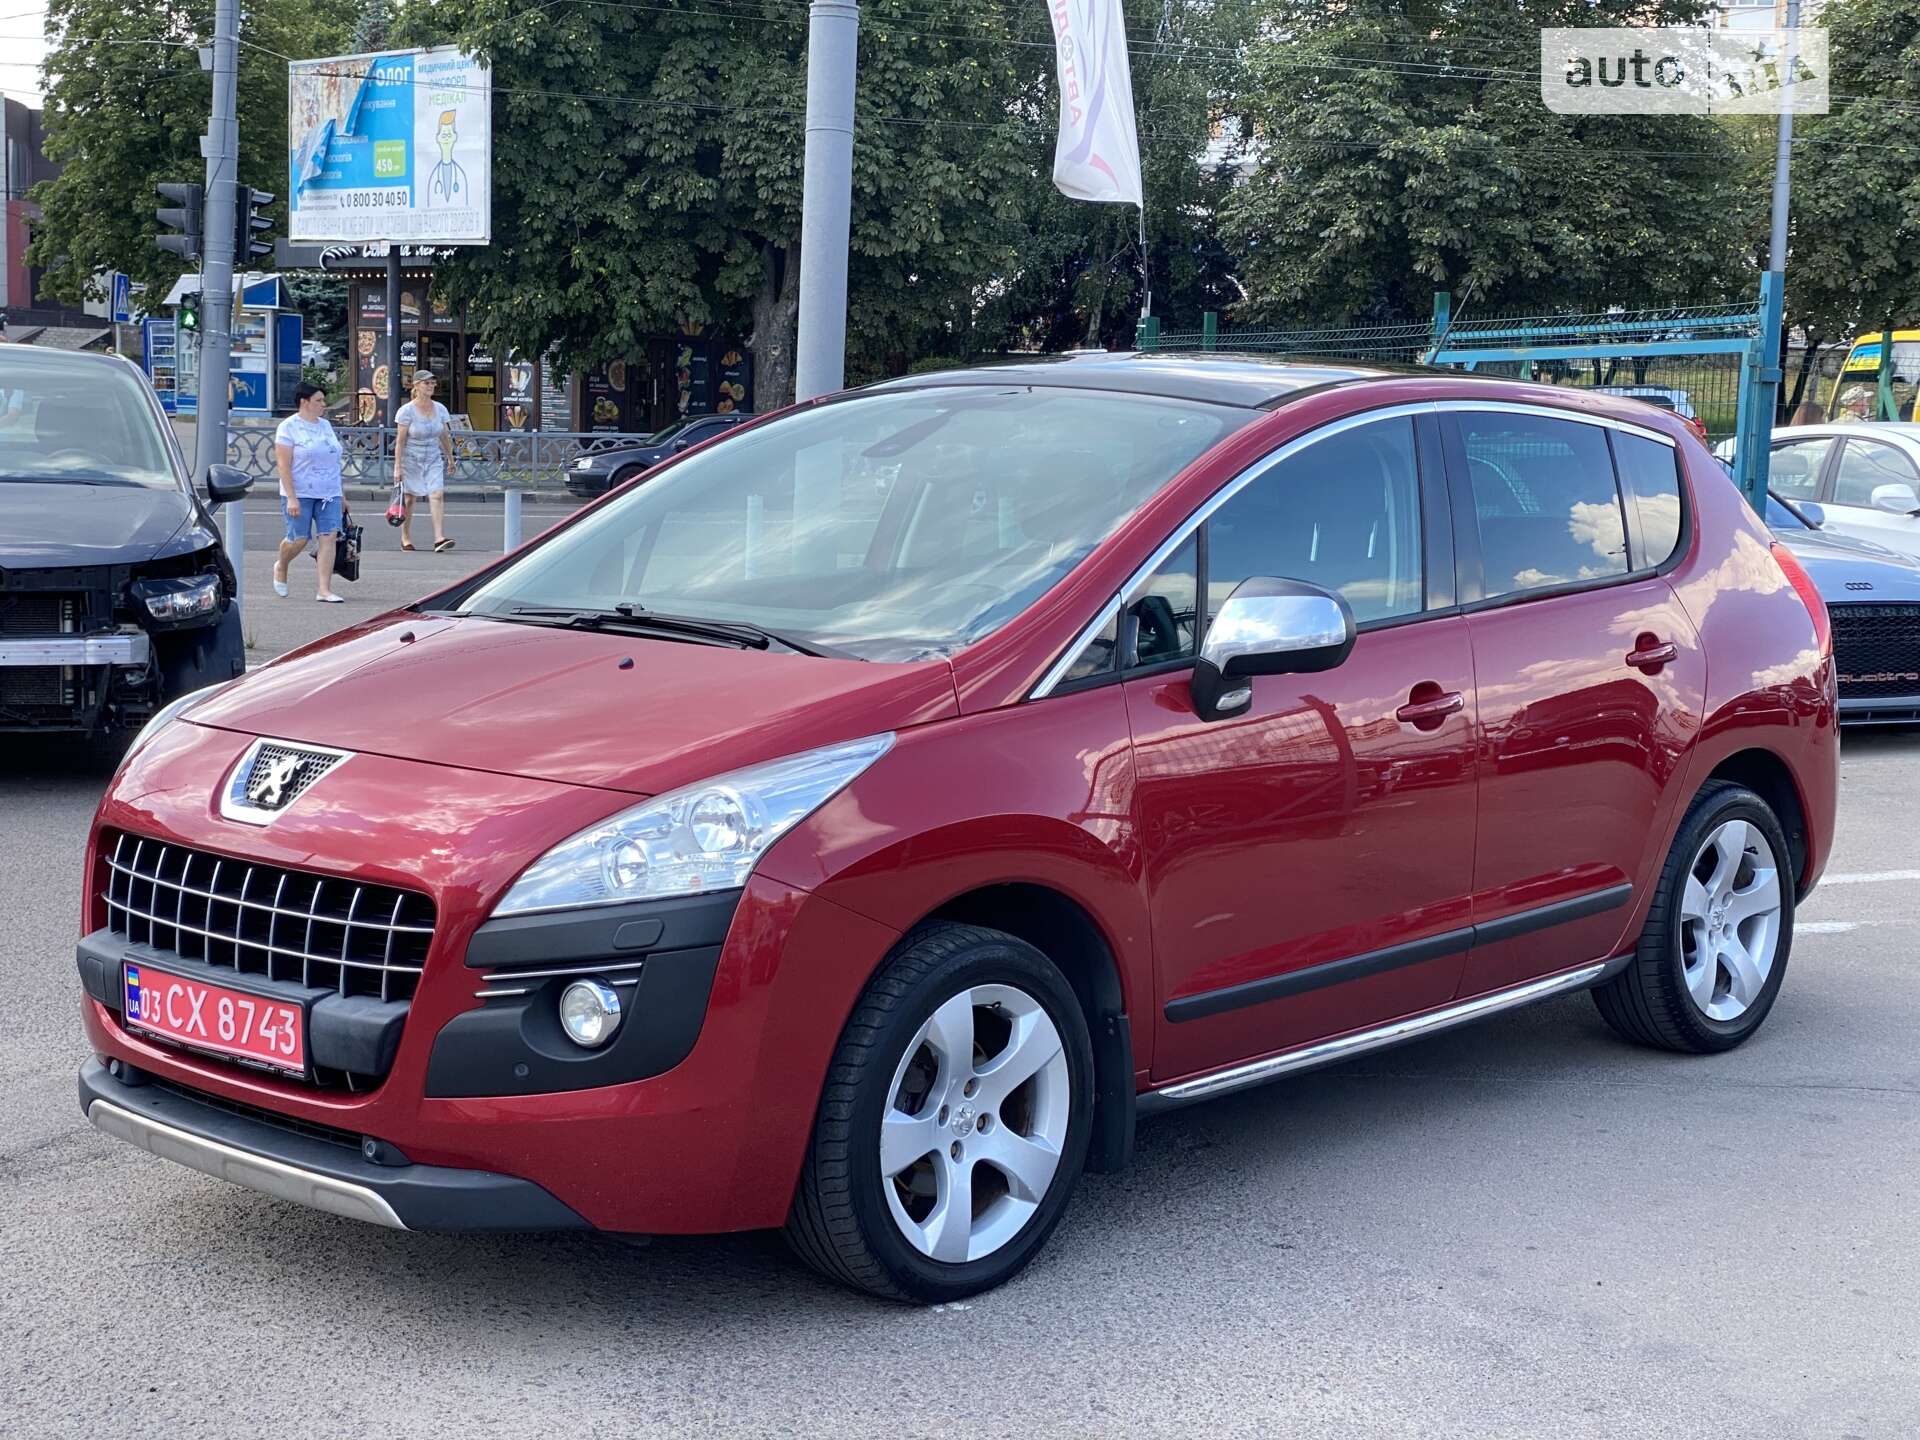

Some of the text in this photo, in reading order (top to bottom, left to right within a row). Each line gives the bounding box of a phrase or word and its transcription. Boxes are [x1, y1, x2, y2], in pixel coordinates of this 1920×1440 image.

[376, 159, 392, 172] 450
[347, 193, 352, 207] 0
[353, 193, 370, 207] 800
[372, 192, 384, 206] 30
[385, 192, 395, 206] 40
[397, 191, 407, 205] 50
[1836, 672, 1919, 684] quattro
[129, 1000, 140, 1014] UA
[140, 984, 296, 1055] 03 CX 8743
